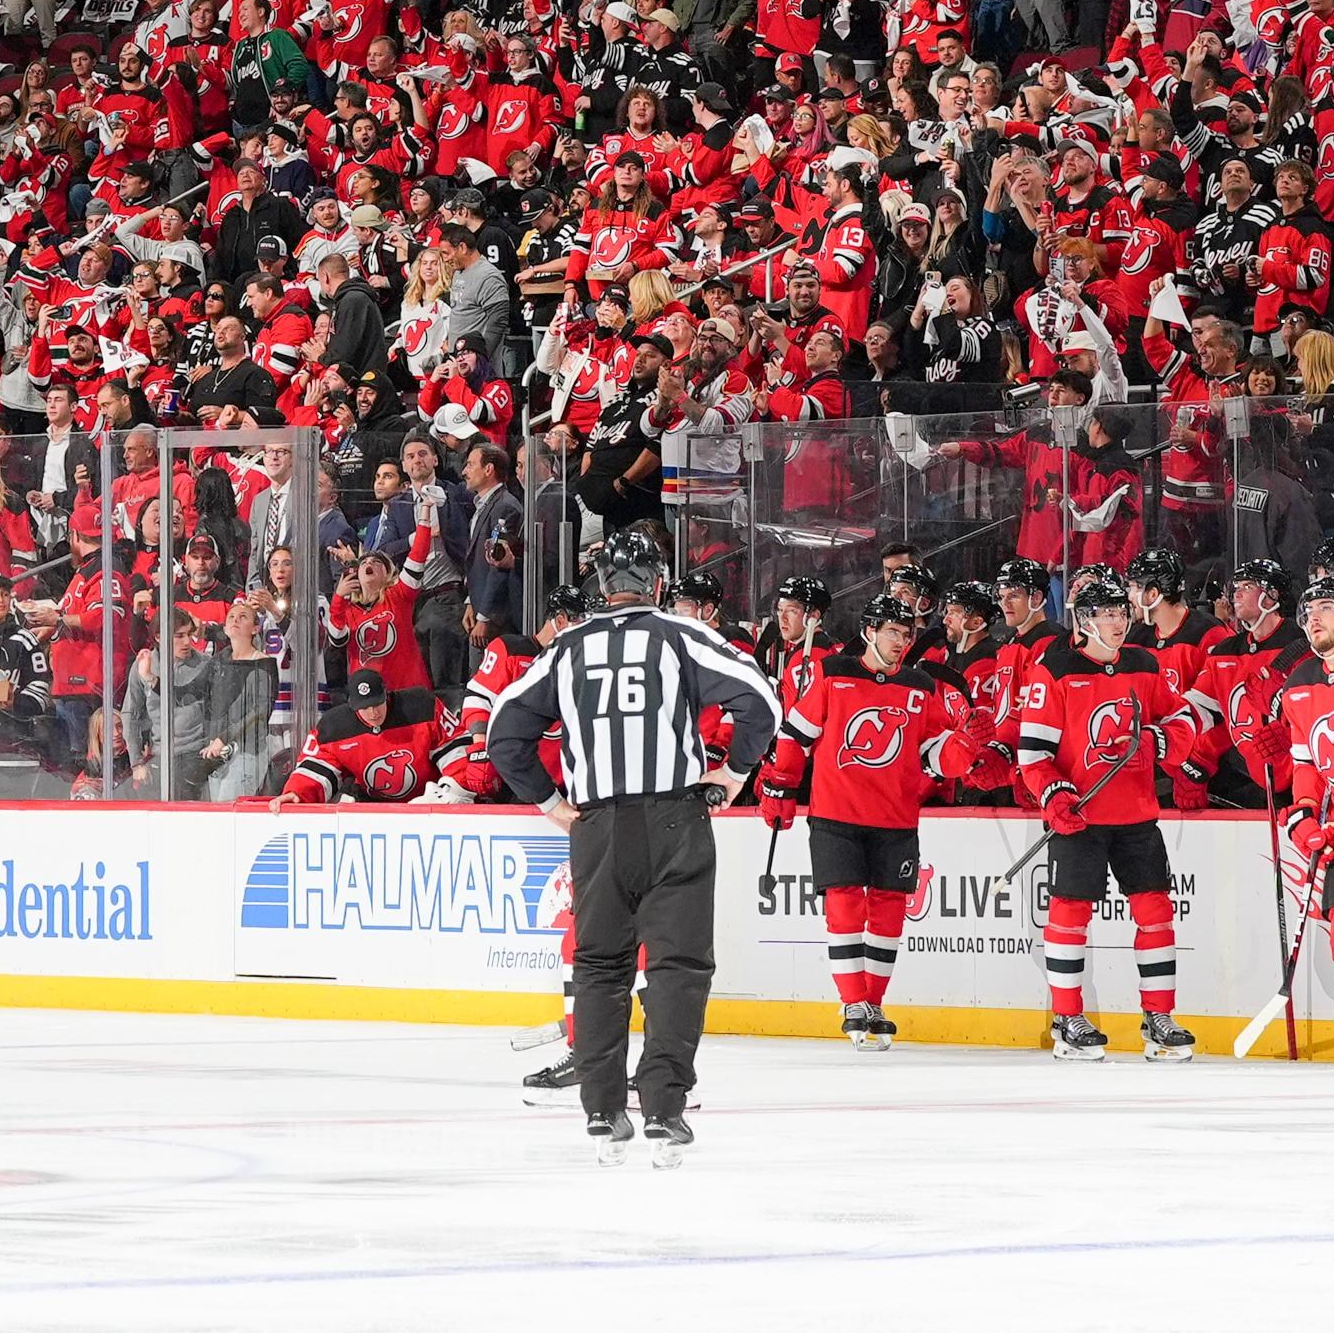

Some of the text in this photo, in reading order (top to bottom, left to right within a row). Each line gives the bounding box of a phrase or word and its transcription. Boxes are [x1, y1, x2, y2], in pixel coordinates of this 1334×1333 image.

[636, 217, 648, 234] C
[1117, 211, 1133, 229] 13
[840, 226, 864, 247] 13
[487, 243, 499, 262] 9
[1205, 238, 1253, 266] Jersey
[1308, 248, 1329, 270] 86
[485, 384, 507, 408] 13
[31, 651, 48, 674] 8
[586, 667, 646, 715] 76
[971, 676, 996, 700] 14
[906, 689, 922, 713] C
[292, 834, 536, 933] HALMAR
[940, 875, 1012, 918] LIVE
[907, 936, 1034, 955] DOWNLOAD TODAY
[486, 945, 563, 971] Internation
